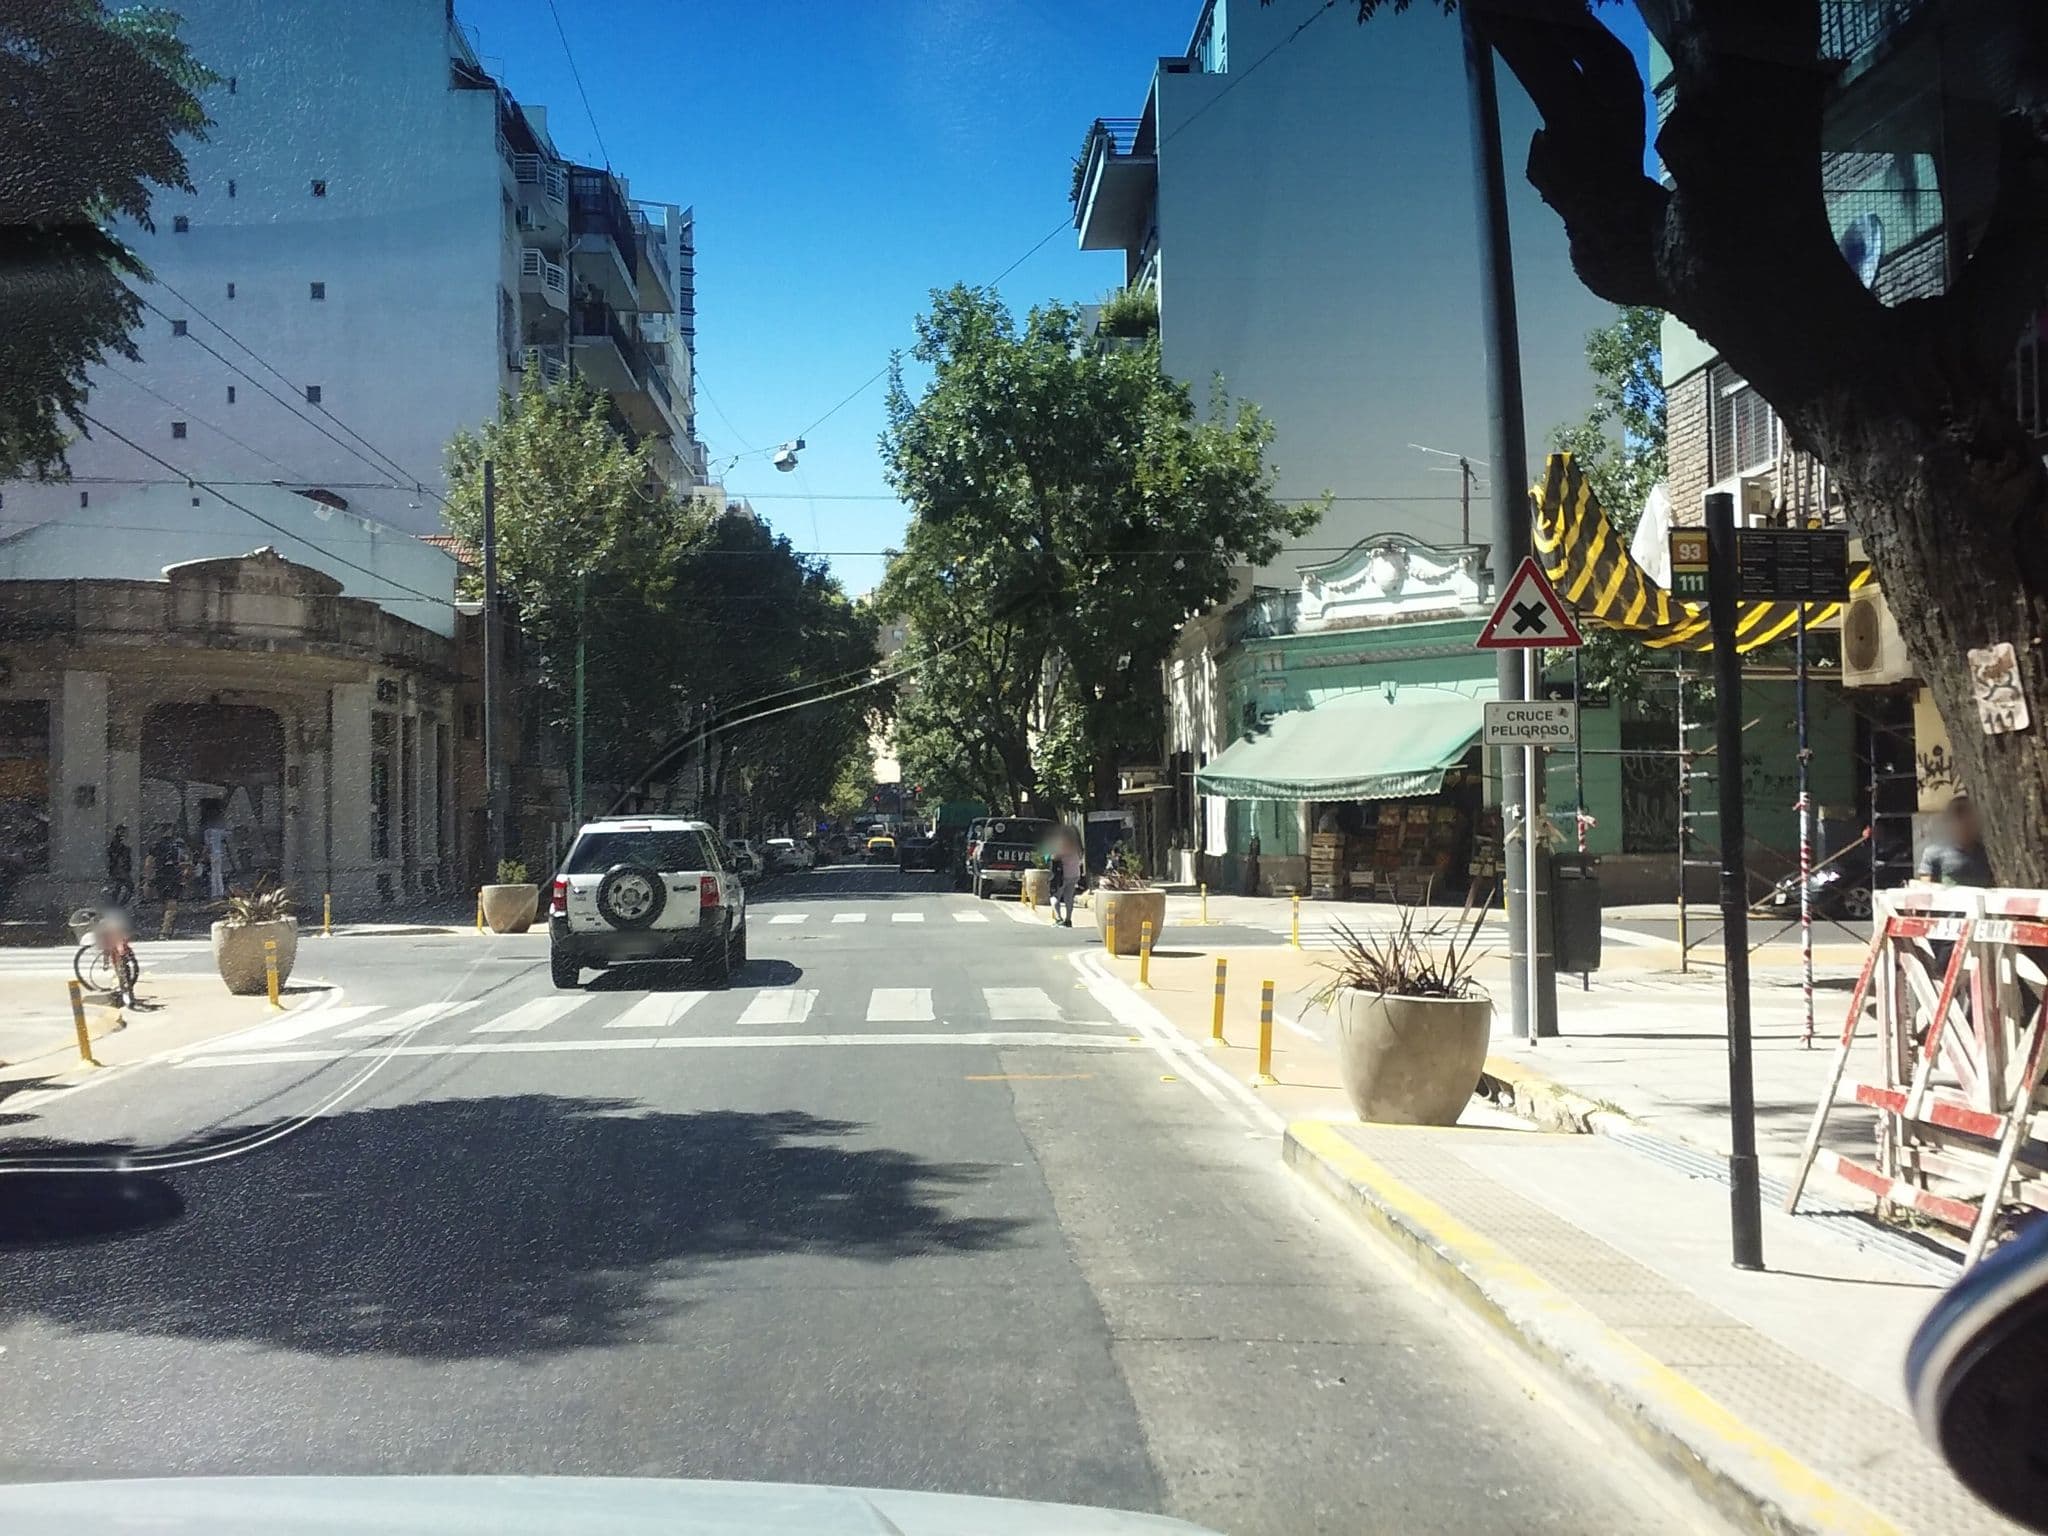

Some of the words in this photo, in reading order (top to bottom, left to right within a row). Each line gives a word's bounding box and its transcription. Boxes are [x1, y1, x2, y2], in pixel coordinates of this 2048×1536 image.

[1679, 543, 1701, 560] 93
[1679, 575, 1704, 591] 111
[1506, 710, 1554, 721] CRUCE
[1491, 724, 1570, 736] PELIGROSO
[997, 850, 1031, 861] CHEVR
